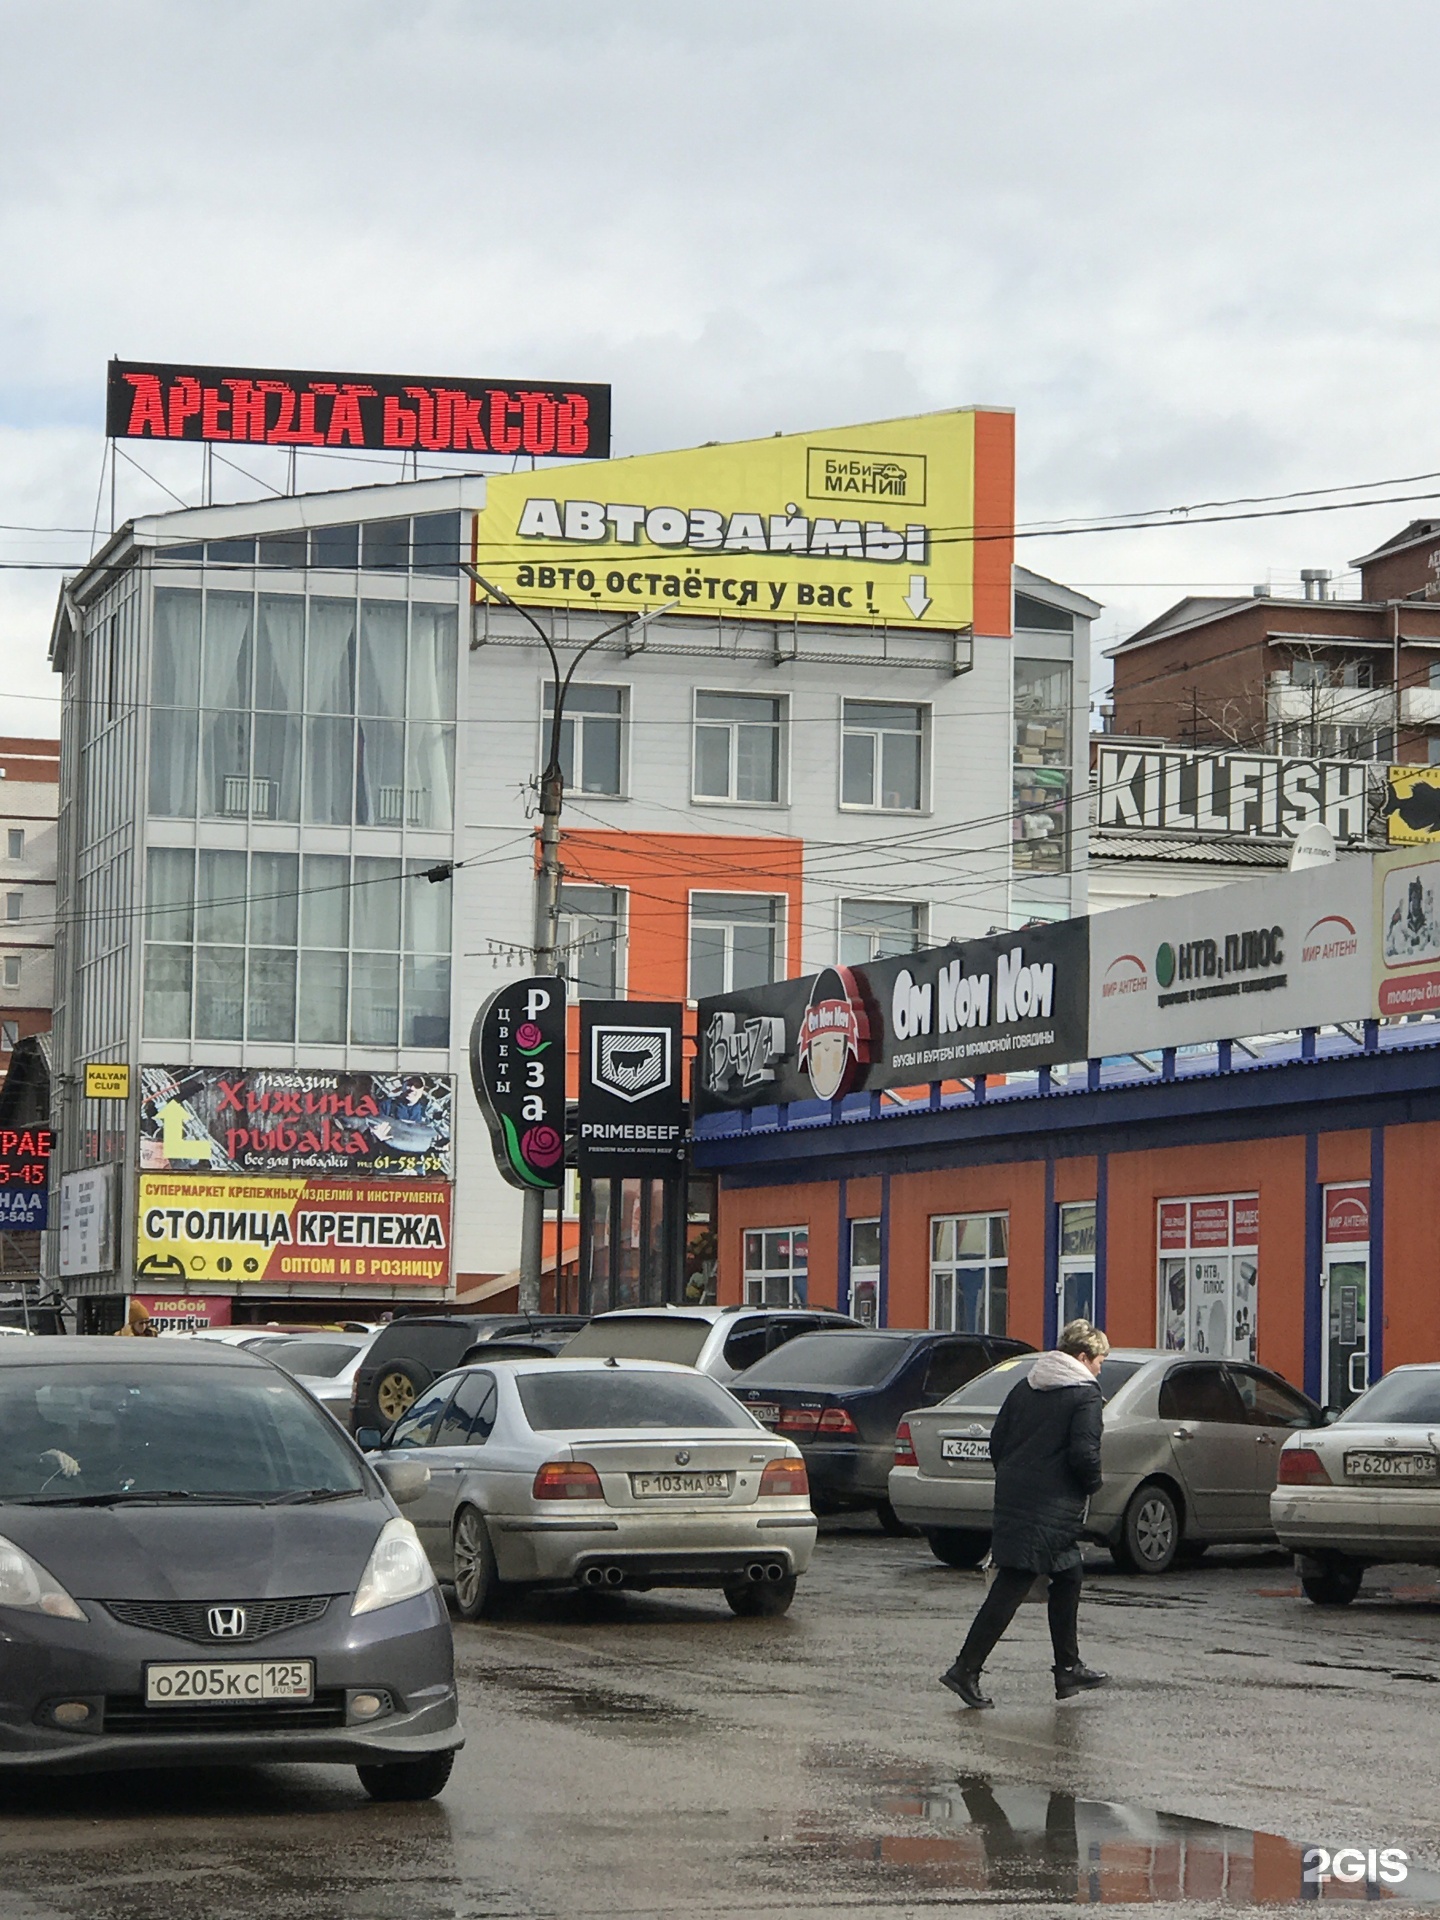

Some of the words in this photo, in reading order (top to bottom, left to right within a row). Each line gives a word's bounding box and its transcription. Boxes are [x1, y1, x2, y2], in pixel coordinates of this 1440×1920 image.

[122, 373, 378, 446] АРЕНДА
[383, 386, 591, 456] БОКСОВ
[516, 498, 926, 562] АВТОЗАЙМЫ
[517, 564, 596, 590] авто
[606, 567, 759, 601] остаётся
[769, 579, 786, 610] у
[799, 583, 853, 608] вас
[1099, 751, 1366, 840] KILLFISH
[1225, 925, 1284, 972] ПЛЮС
[1302, 945, 1321, 962] МИР
[1322, 939, 1357, 959] АНТЕНН
[892, 969, 931, 1040] Ом
[939, 959, 990, 1034] Ком
[997, 947, 1054, 1024] Ком
[496, 1008, 511, 1093] ЦВЕТЫ
[88, 1072, 127, 1081] KALYAN
[94, 1081, 121, 1090] CLUB
[216, 1080, 379, 1116] Хижина
[225, 1116, 369, 1160] рыбака
[581, 1124, 679, 1139] PRIMEBEEF
[266, 1156, 289, 1169] для
[292, 1153, 348, 1172] рыбалки
[146, 1183, 225, 1198] СУПЕРМАРКЕТ
[228, 1186, 298, 1200] КРЕПЕЖНЫХ
[302, 1187, 353, 1201] ИЗДЕЛИЙ
[357, 1190, 364, 1201] И
[368, 1190, 445, 1204] ИНСТРУМЕНТА
[146, 1210, 290, 1246] СТОЛИЦА
[300, 1214, 443, 1246] КРЕПЕЖА
[281, 1257, 334, 1274] ОПТОМ
[340, 1258, 350, 1274] И
[355, 1259, 365, 1275] В
[371, 1259, 443, 1279] РОЗНИЦУ
[153, 1299, 206, 1311] любой
[265, 1666, 302, 1686] 125
[273, 1686, 292, 1694] RUS
